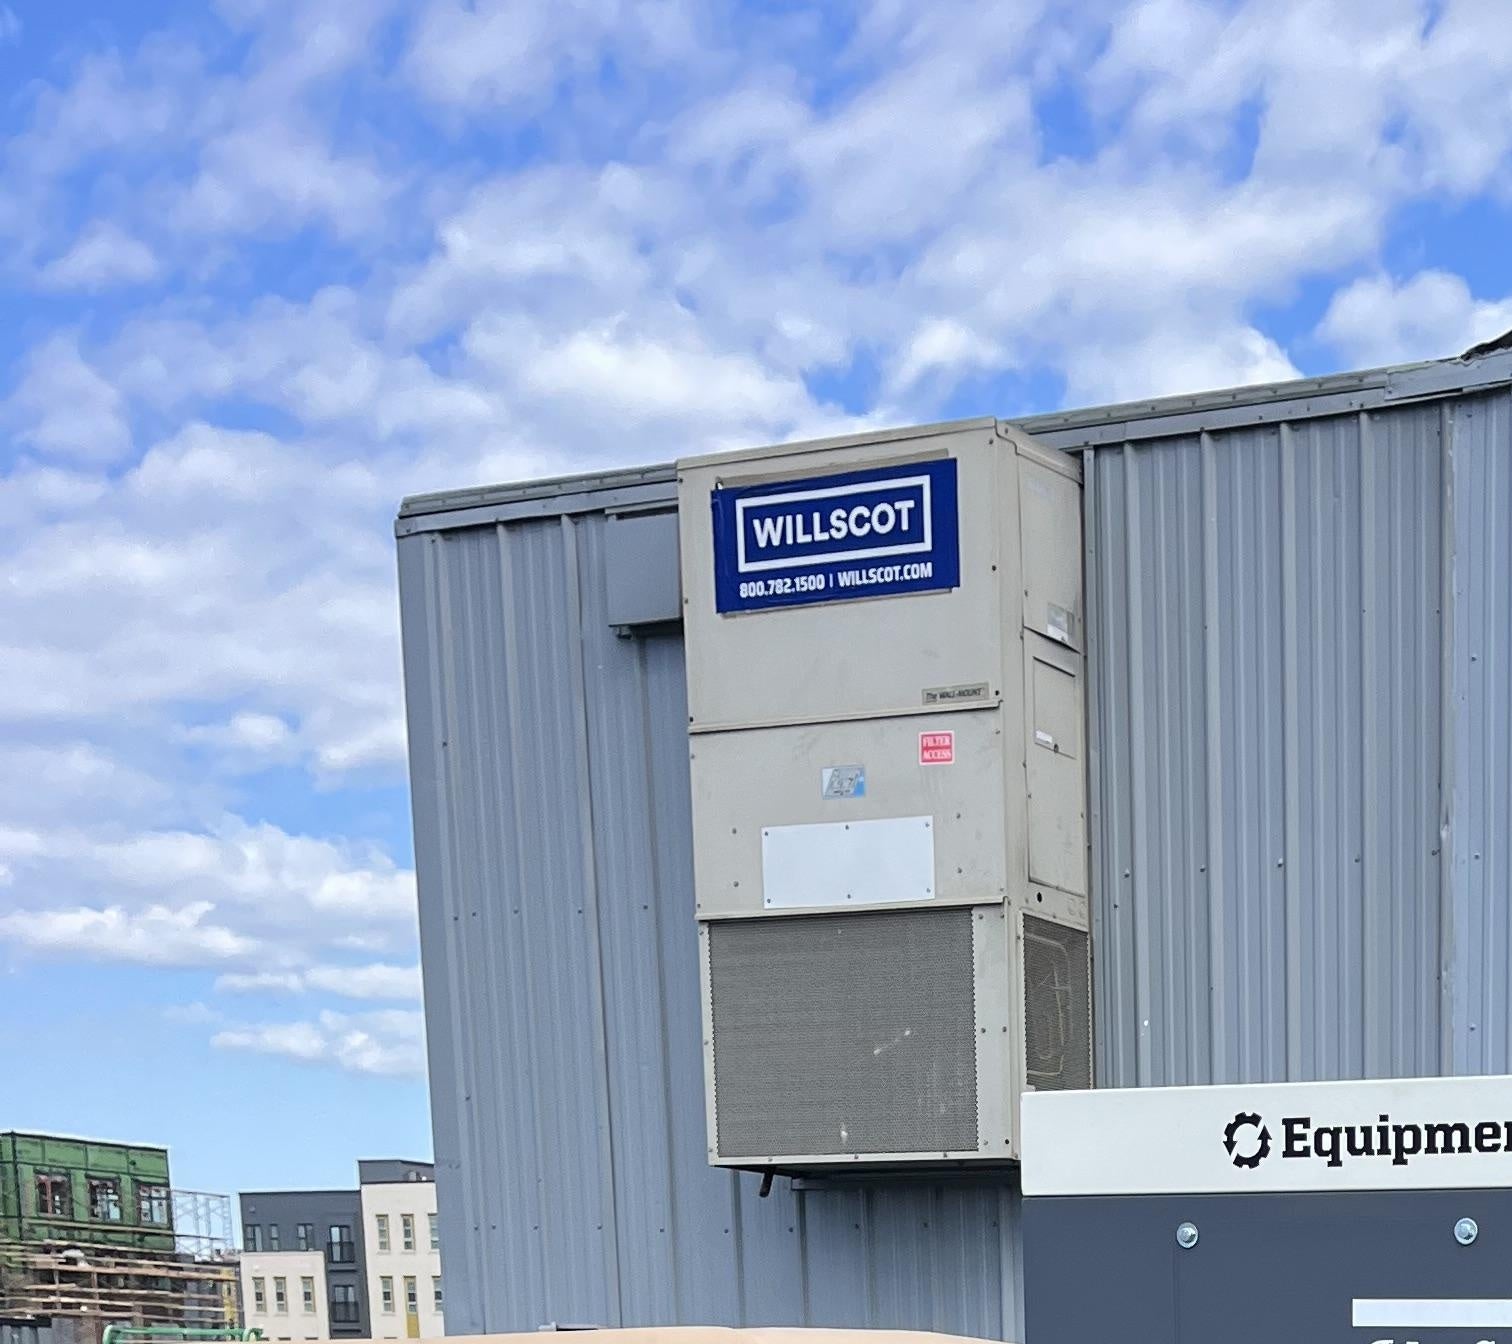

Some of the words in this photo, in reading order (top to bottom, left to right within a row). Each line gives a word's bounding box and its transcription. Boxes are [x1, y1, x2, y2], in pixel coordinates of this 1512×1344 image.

[753, 500, 915, 548] WILLSCOT
[739, 574, 826, 599] 800.782.1500
[837, 562, 933, 588] WILLSCOT.COM
